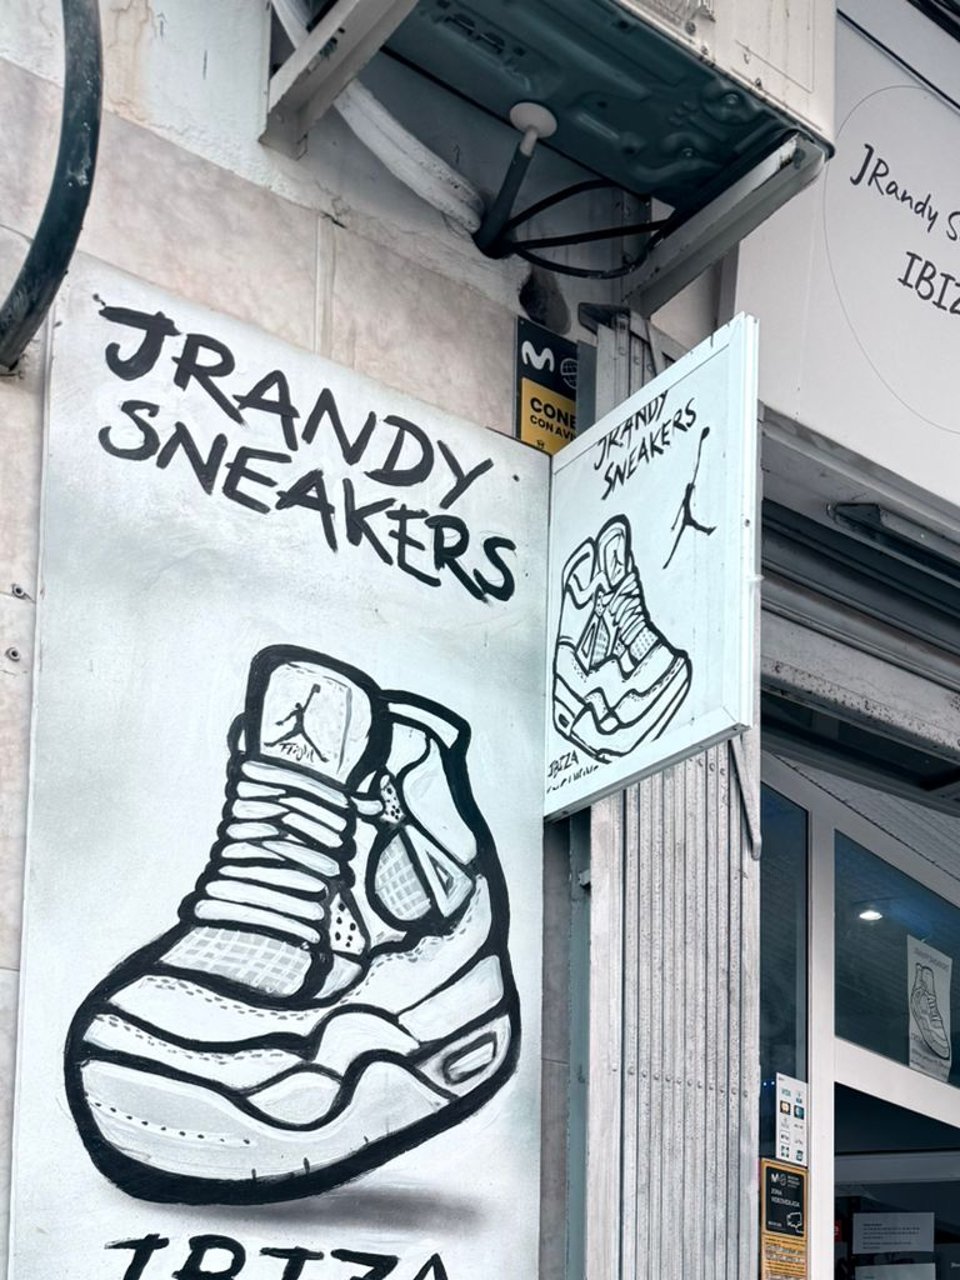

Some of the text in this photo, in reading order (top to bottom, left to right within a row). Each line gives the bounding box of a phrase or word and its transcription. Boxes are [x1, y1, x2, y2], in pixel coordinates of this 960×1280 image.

[850, 143, 939, 233] JRandy
[99, 304, 494, 509] JRANDY
[529, 414, 554, 433] CON
[601, 397, 697, 500] SNEAKERS
[98, 400, 516, 602] SNEAKERS
